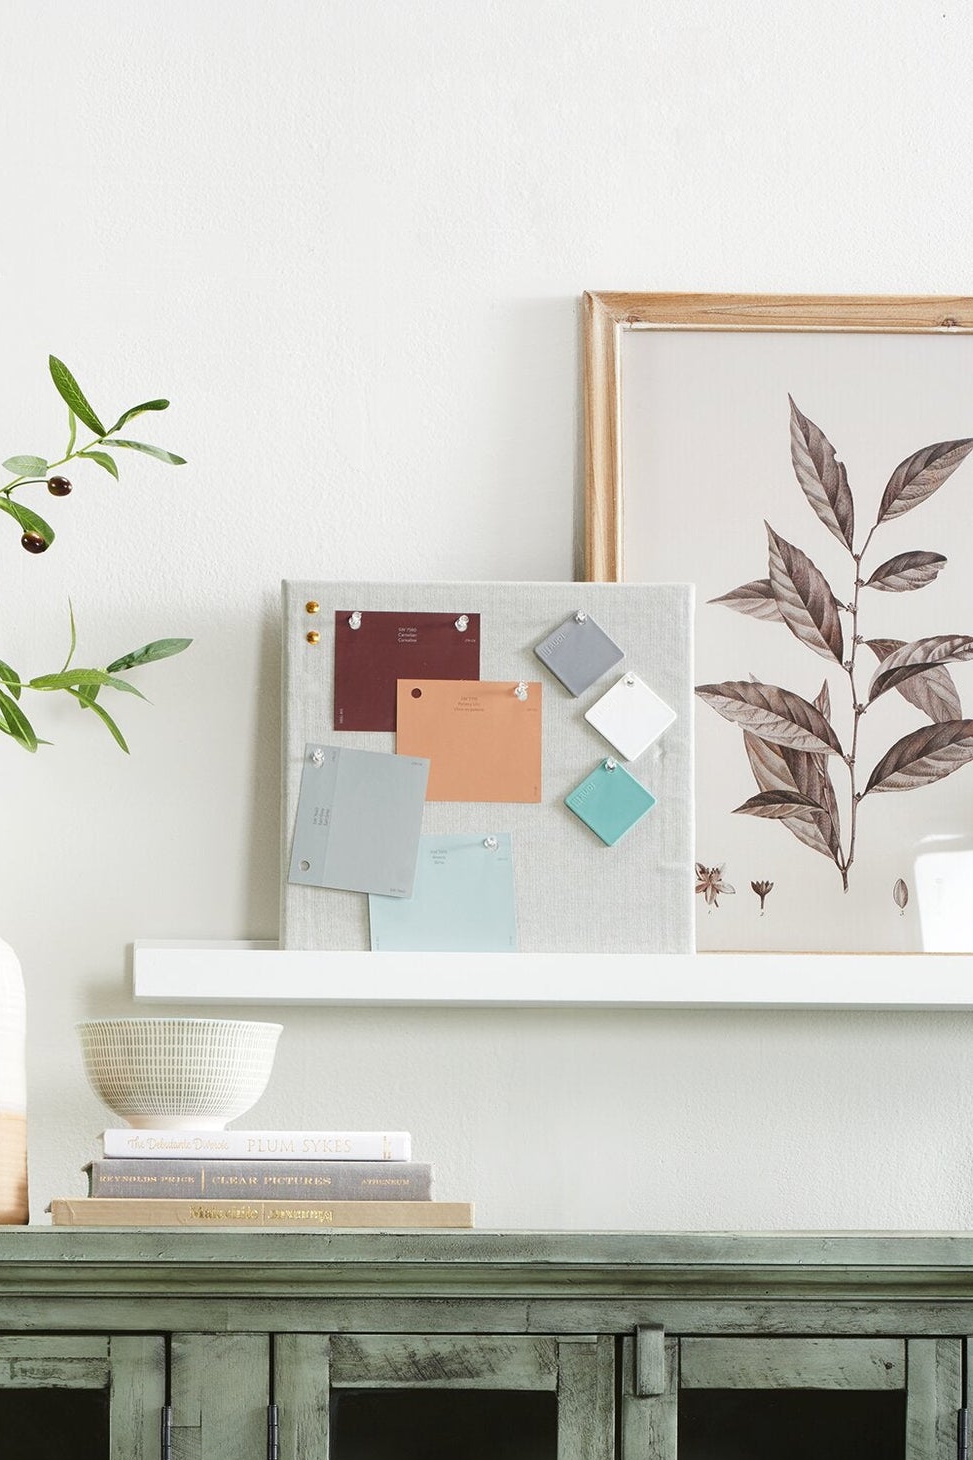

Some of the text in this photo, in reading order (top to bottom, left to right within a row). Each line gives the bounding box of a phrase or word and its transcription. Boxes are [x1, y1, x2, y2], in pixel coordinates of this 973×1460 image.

[247, 1138, 295, 1153] PLUM
[302, 1139, 353, 1153] SYKES
[99, 1175, 195, 1183] REYNOLDS PRICE
[212, 1176, 332, 1186] CLEAR PICTURES
